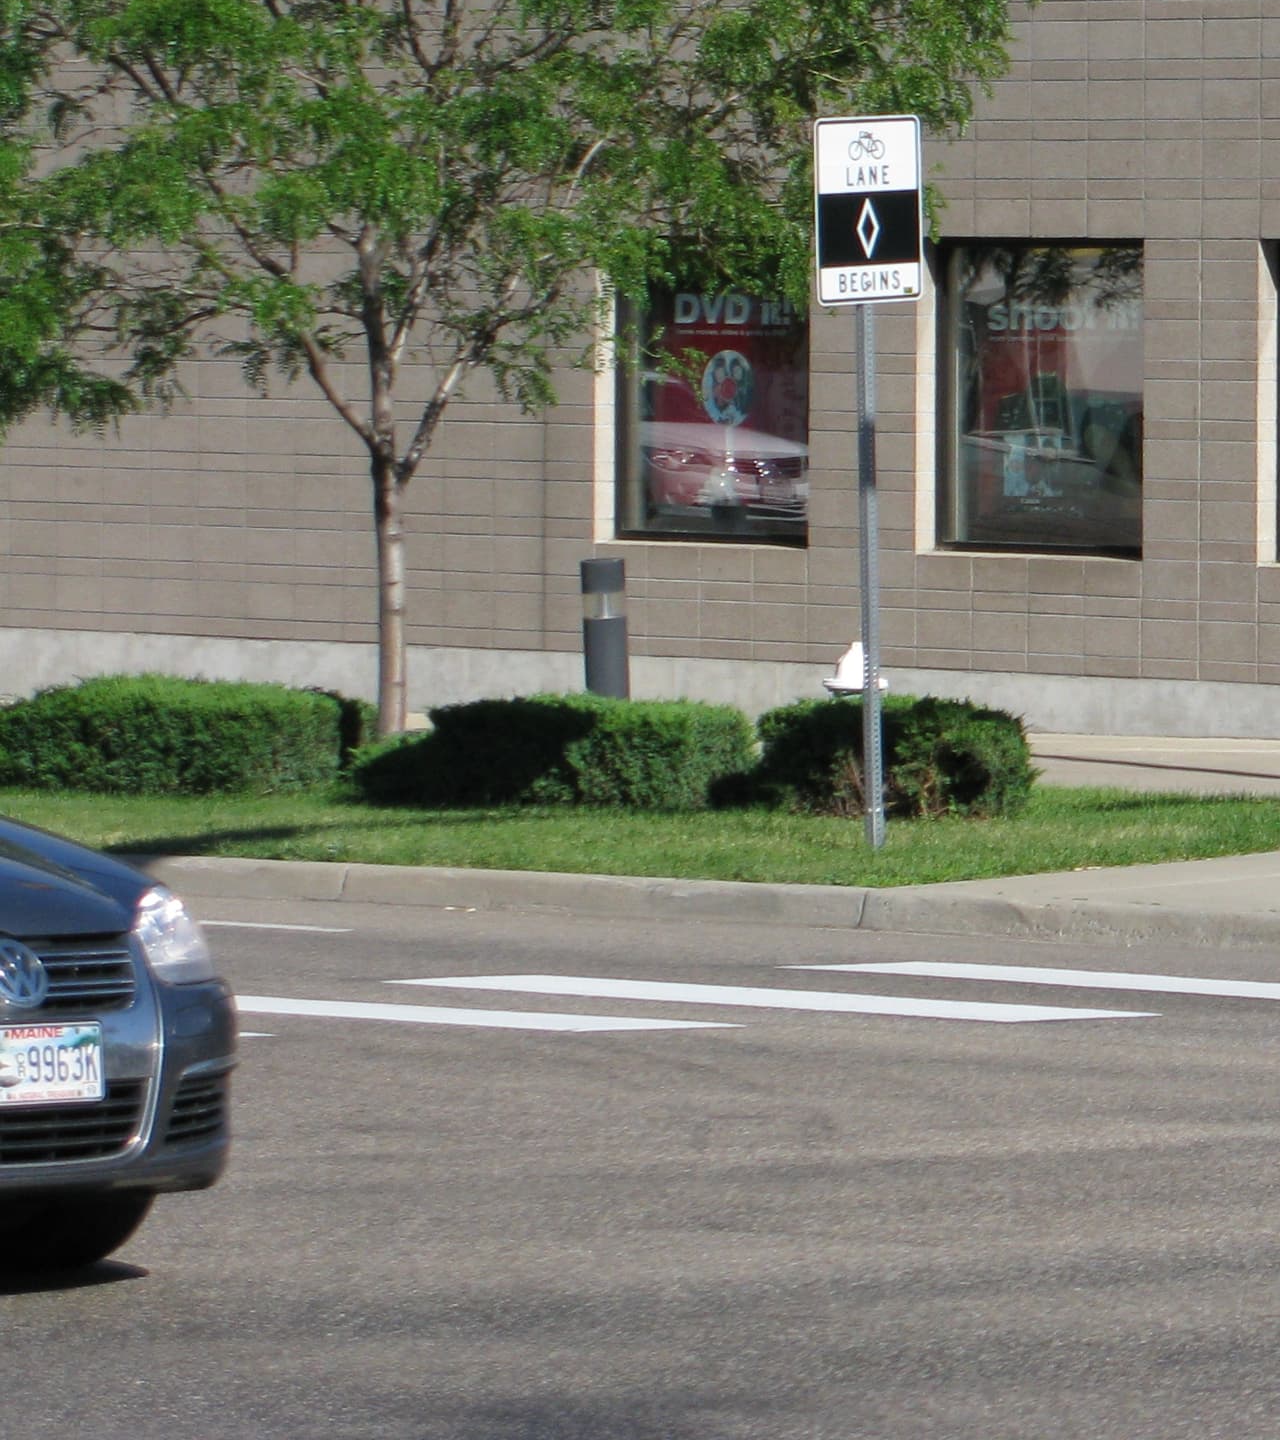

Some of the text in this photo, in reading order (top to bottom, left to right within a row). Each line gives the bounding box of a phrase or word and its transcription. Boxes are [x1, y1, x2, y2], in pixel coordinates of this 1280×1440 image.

[846, 165, 890, 187] LANE
[838, 270, 901, 293] BEGINS
[674, 292, 752, 325] DVD
[10, 1027, 64, 1039] MAINE
[27, 1044, 98, 1083] 9963K
